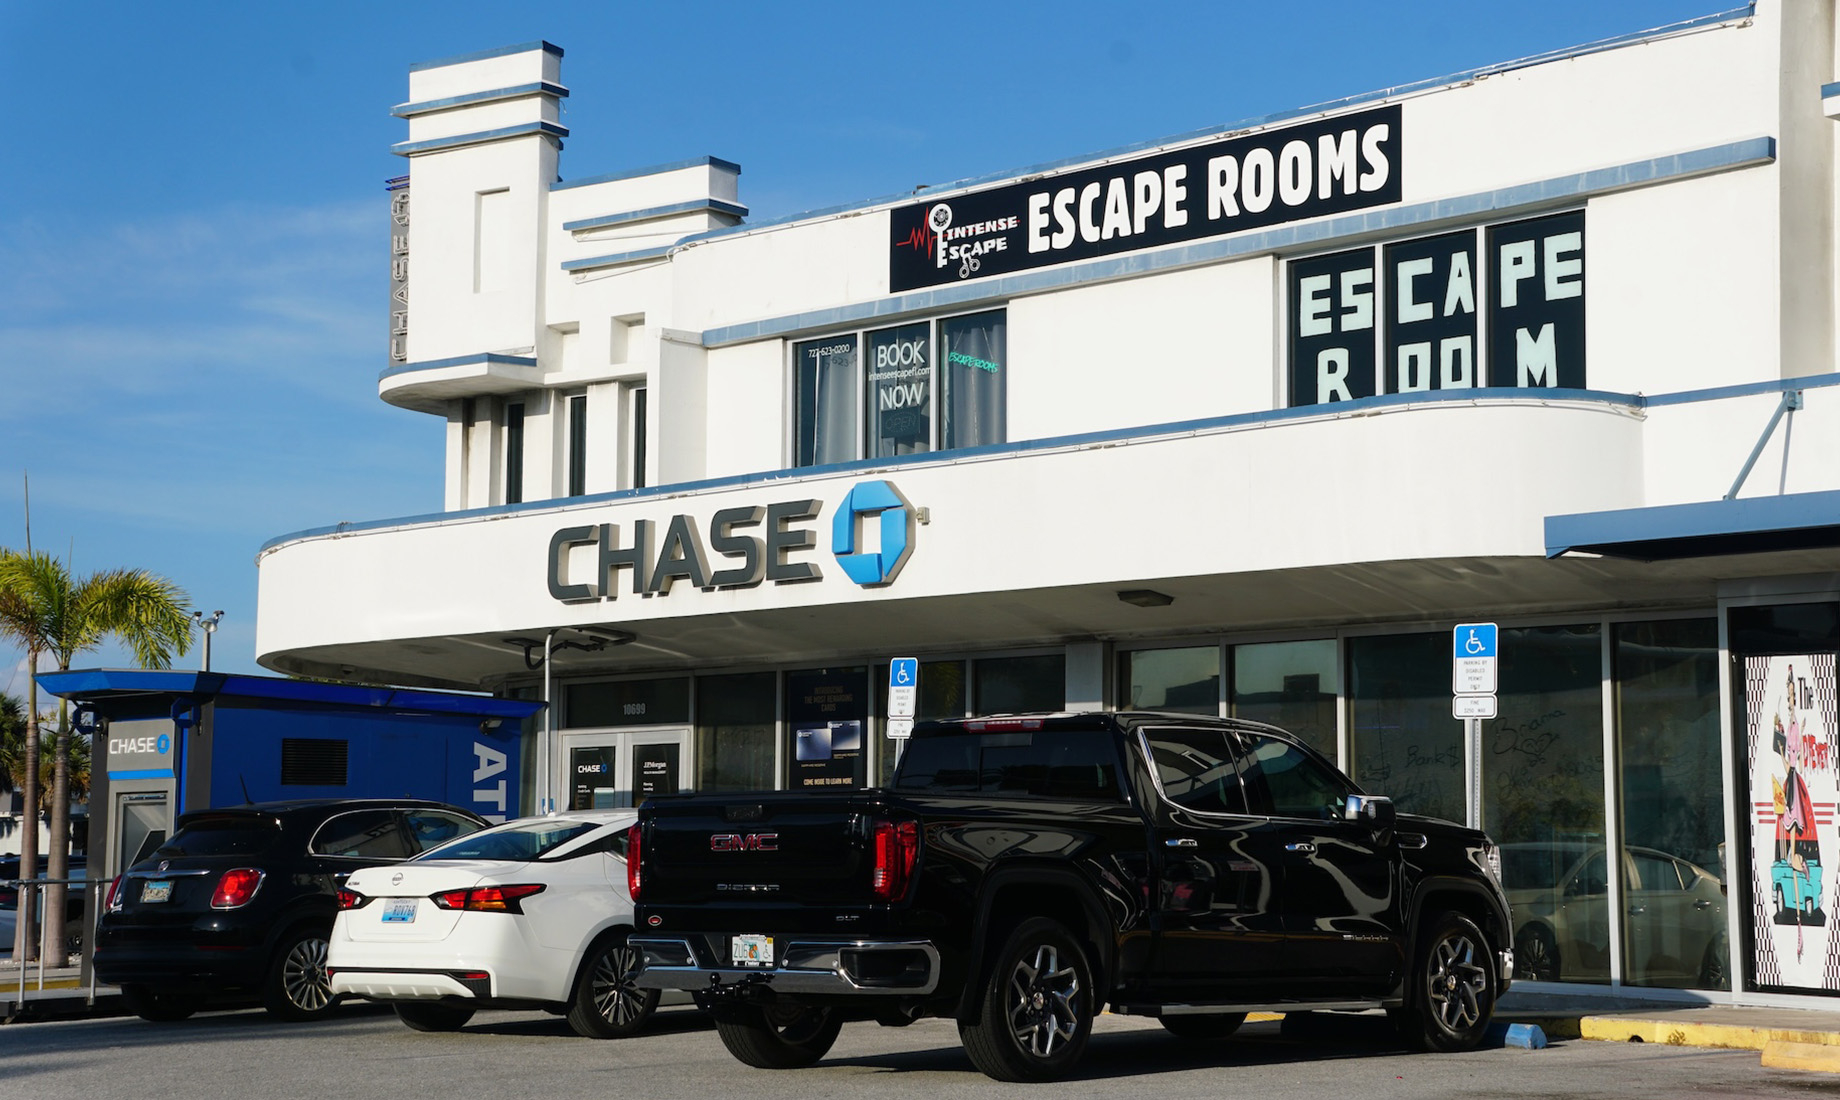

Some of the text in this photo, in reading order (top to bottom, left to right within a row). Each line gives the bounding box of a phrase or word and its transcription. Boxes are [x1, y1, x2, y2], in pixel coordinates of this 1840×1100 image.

[1027, 123, 1390, 254] ESCAPE ROOMS
[946, 215, 1018, 240] INTENSE
[937, 237, 1008, 268] ESCAPE
[1300, 231, 1582, 338] ESCAPE
[808, 344, 850, 358] 727-623-0200
[877, 340, 926, 368] BOOK
[948, 351, 999, 374] ESCAPE ROOMS
[868, 366, 931, 382] intenseescapefl.com
[1317, 323, 1558, 405] ROOM
[880, 382, 924, 410] NOW
[547, 498, 824, 605] CHASE
[1798, 676, 1814, 710] The
[623, 702, 646, 716] 10699
[109, 736, 155, 755] CHASE
[577, 764, 601, 774] CHASE
[803, 778, 814, 786] COME
[825, 778, 831, 786] TO
[842, 777, 853, 785] MORE
[710, 833, 778, 851] GMC
